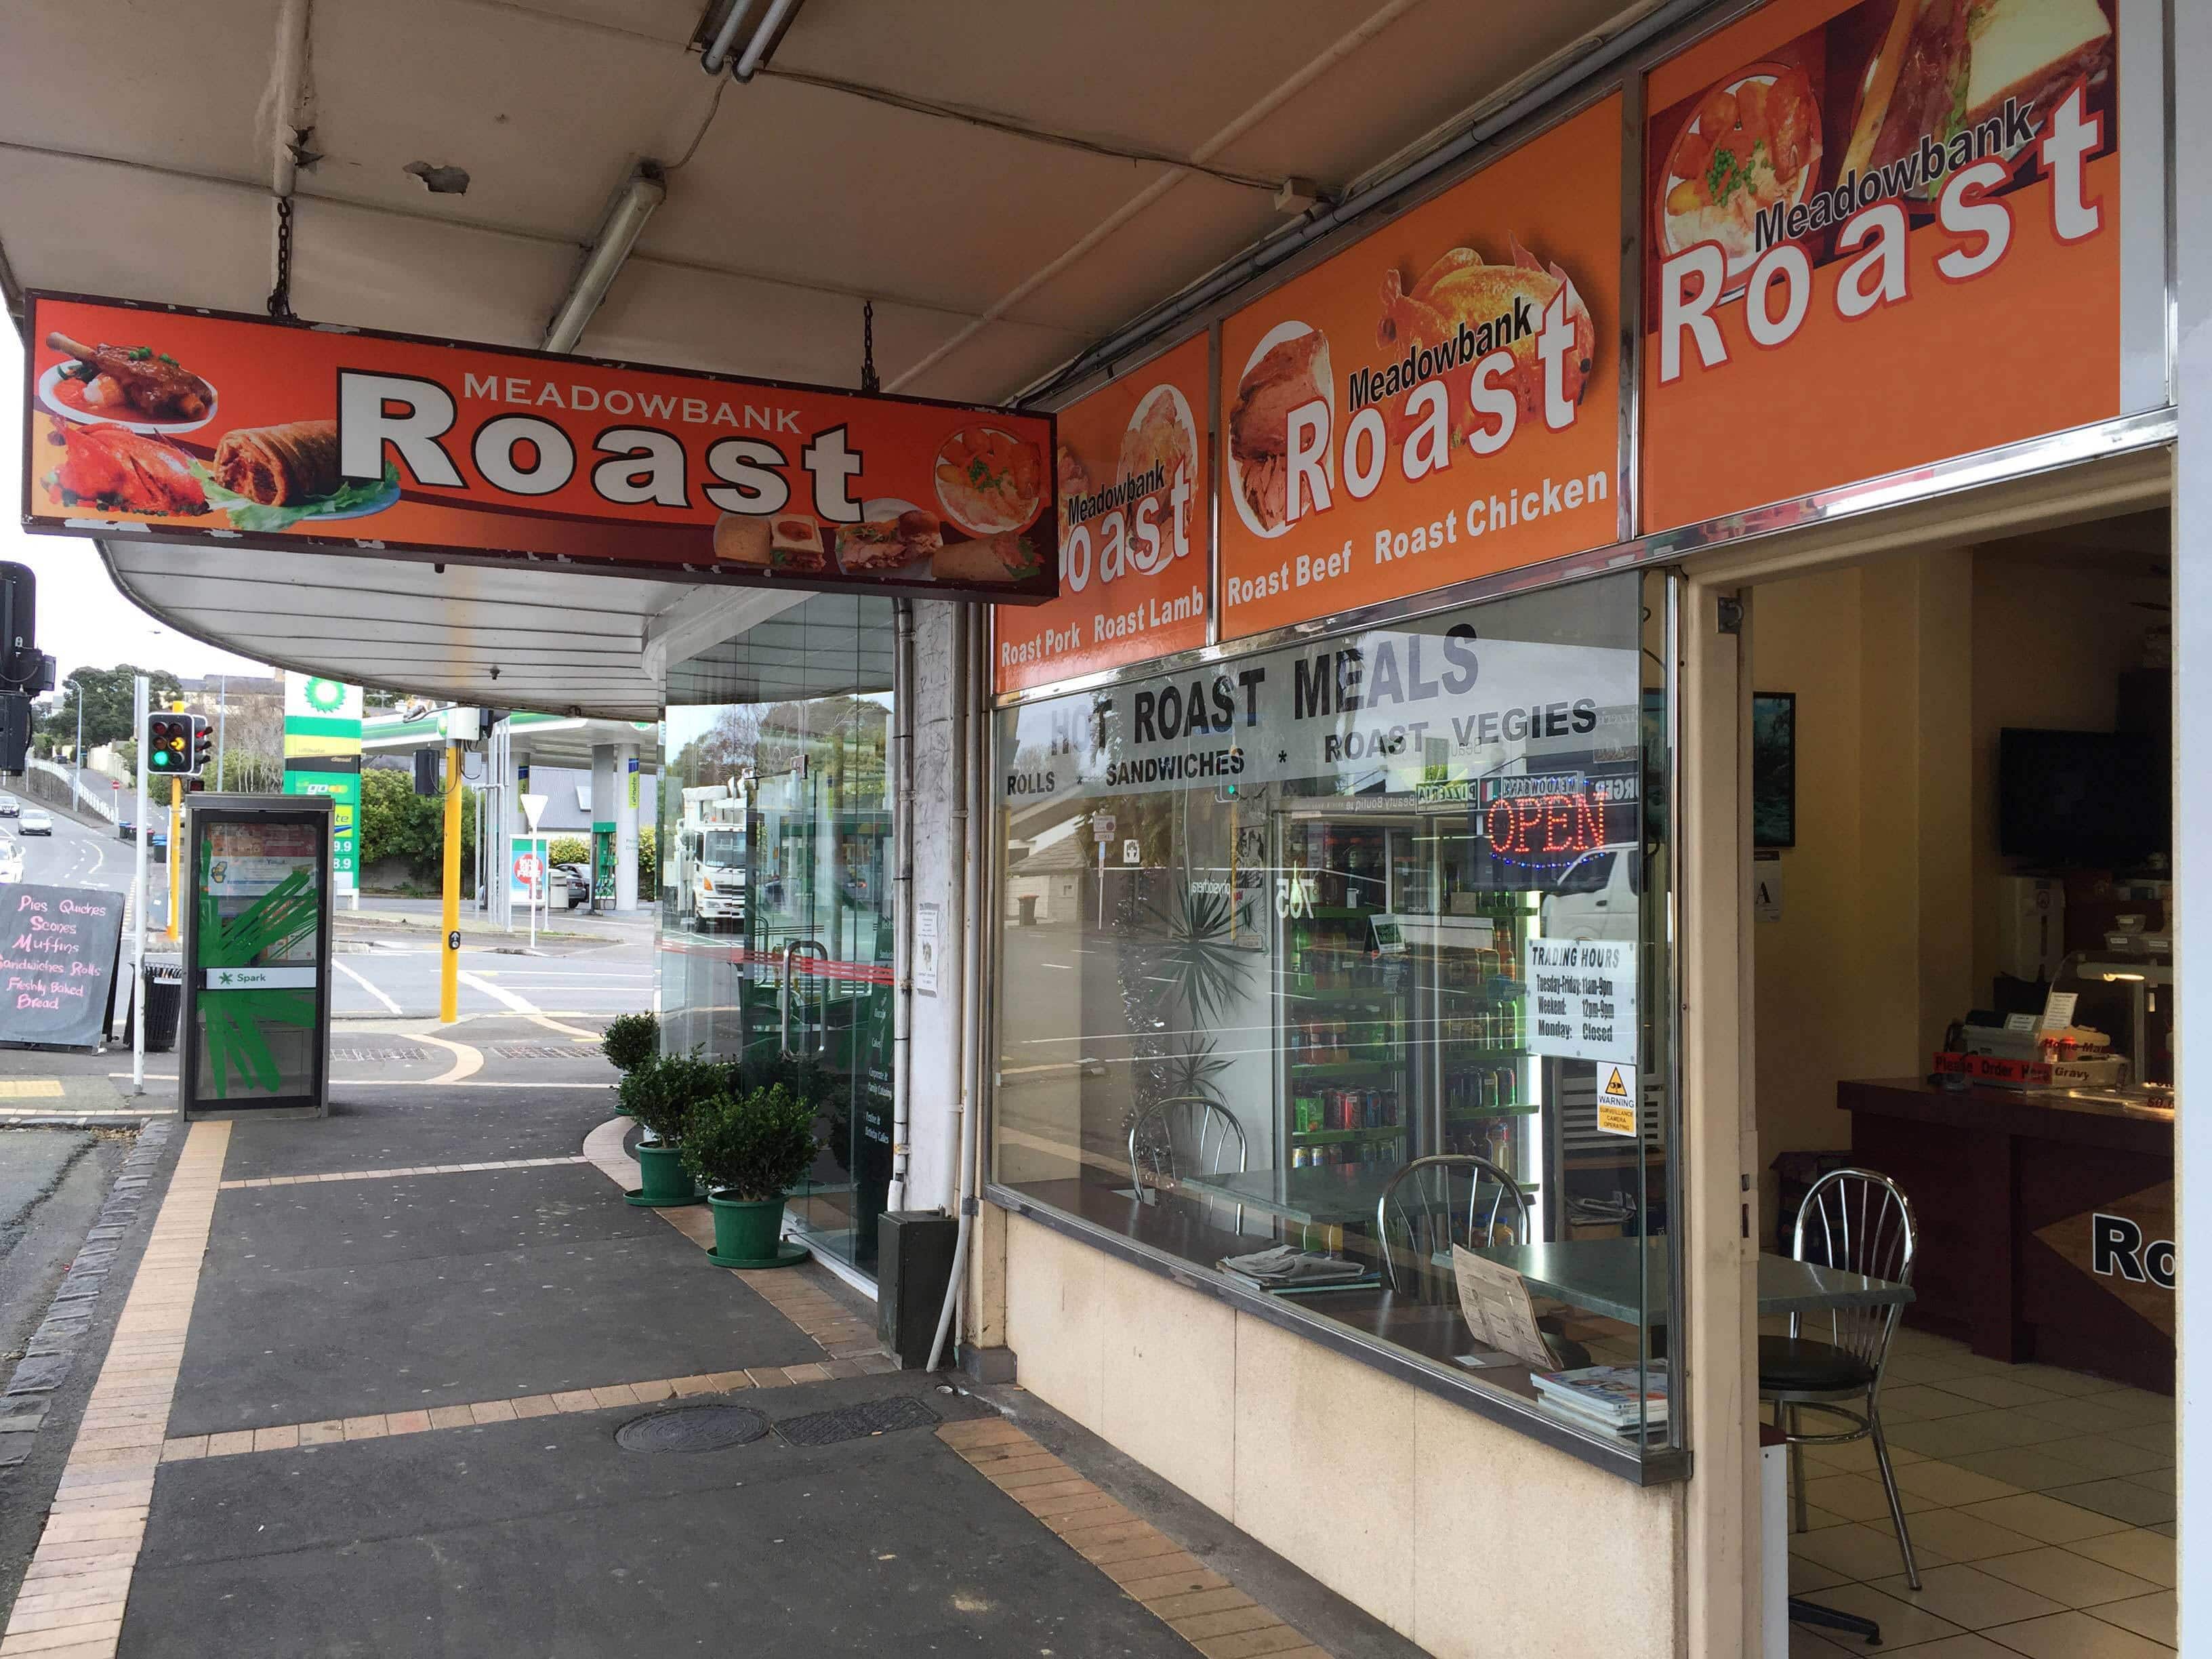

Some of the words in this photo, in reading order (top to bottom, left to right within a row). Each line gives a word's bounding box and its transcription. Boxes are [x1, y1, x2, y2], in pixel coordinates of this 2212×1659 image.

[1755, 97, 2035, 254] Meadowbank
[1658, 73, 2106, 388] Roast
[1349, 296, 1534, 413] Meadowbank
[464, 373, 802, 434] MEADOWBANK
[1285, 279, 1578, 527] Roast
[336, 367, 864, 523] Roast
[1068, 459, 1165, 526] Meadowbank
[1374, 500, 1458, 565] Roast
[1467, 470, 1607, 537] Chicken
[1059, 455, 1191, 592] oast
[1228, 562, 1289, 607] Roast
[1296, 540, 1352, 588] Beef
[1094, 602, 1145, 642] Roast
[1150, 585, 1204, 628] Lamb
[1002, 634, 1042, 668] Roast
[1045, 622, 1081, 653] Pork
[1050, 699, 1113, 756] HOT
[1134, 667, 1265, 744] ROAST
[1294, 623, 1479, 721] MEALS
[1325, 721, 1429, 763] ROAST
[1451, 698, 1597, 748] VEGIES
[1007, 771, 1055, 796] ROLLS
[1106, 747, 1244, 787] SANDWICHES
[1488, 792, 1609, 853] OPEN
[18, 895, 47, 912] Pies
[59, 899, 106, 917] Quiches
[30, 916, 77, 934] Scones
[12, 933, 79, 954] Muffins
[1532, 947, 1577, 967] TRADING
[1581, 947, 1620, 968] HOURS
[6, 977, 47, 995] Freshly
[50, 982, 85, 998] Baked
[70, 962, 101, 977] Rolls
[237, 973, 266, 983] Spark
[16, 994, 60, 1010] Bread
[1538, 1019, 1572, 1040] Monday:
[1582, 1023, 1613, 1042] Closed
[1982, 1060, 2013, 1076] Order
[2055, 1067, 2089, 1081] Gravy
[1599, 1095, 1634, 1108] WARNING
[2092, 1212, 2175, 1290] Ro
